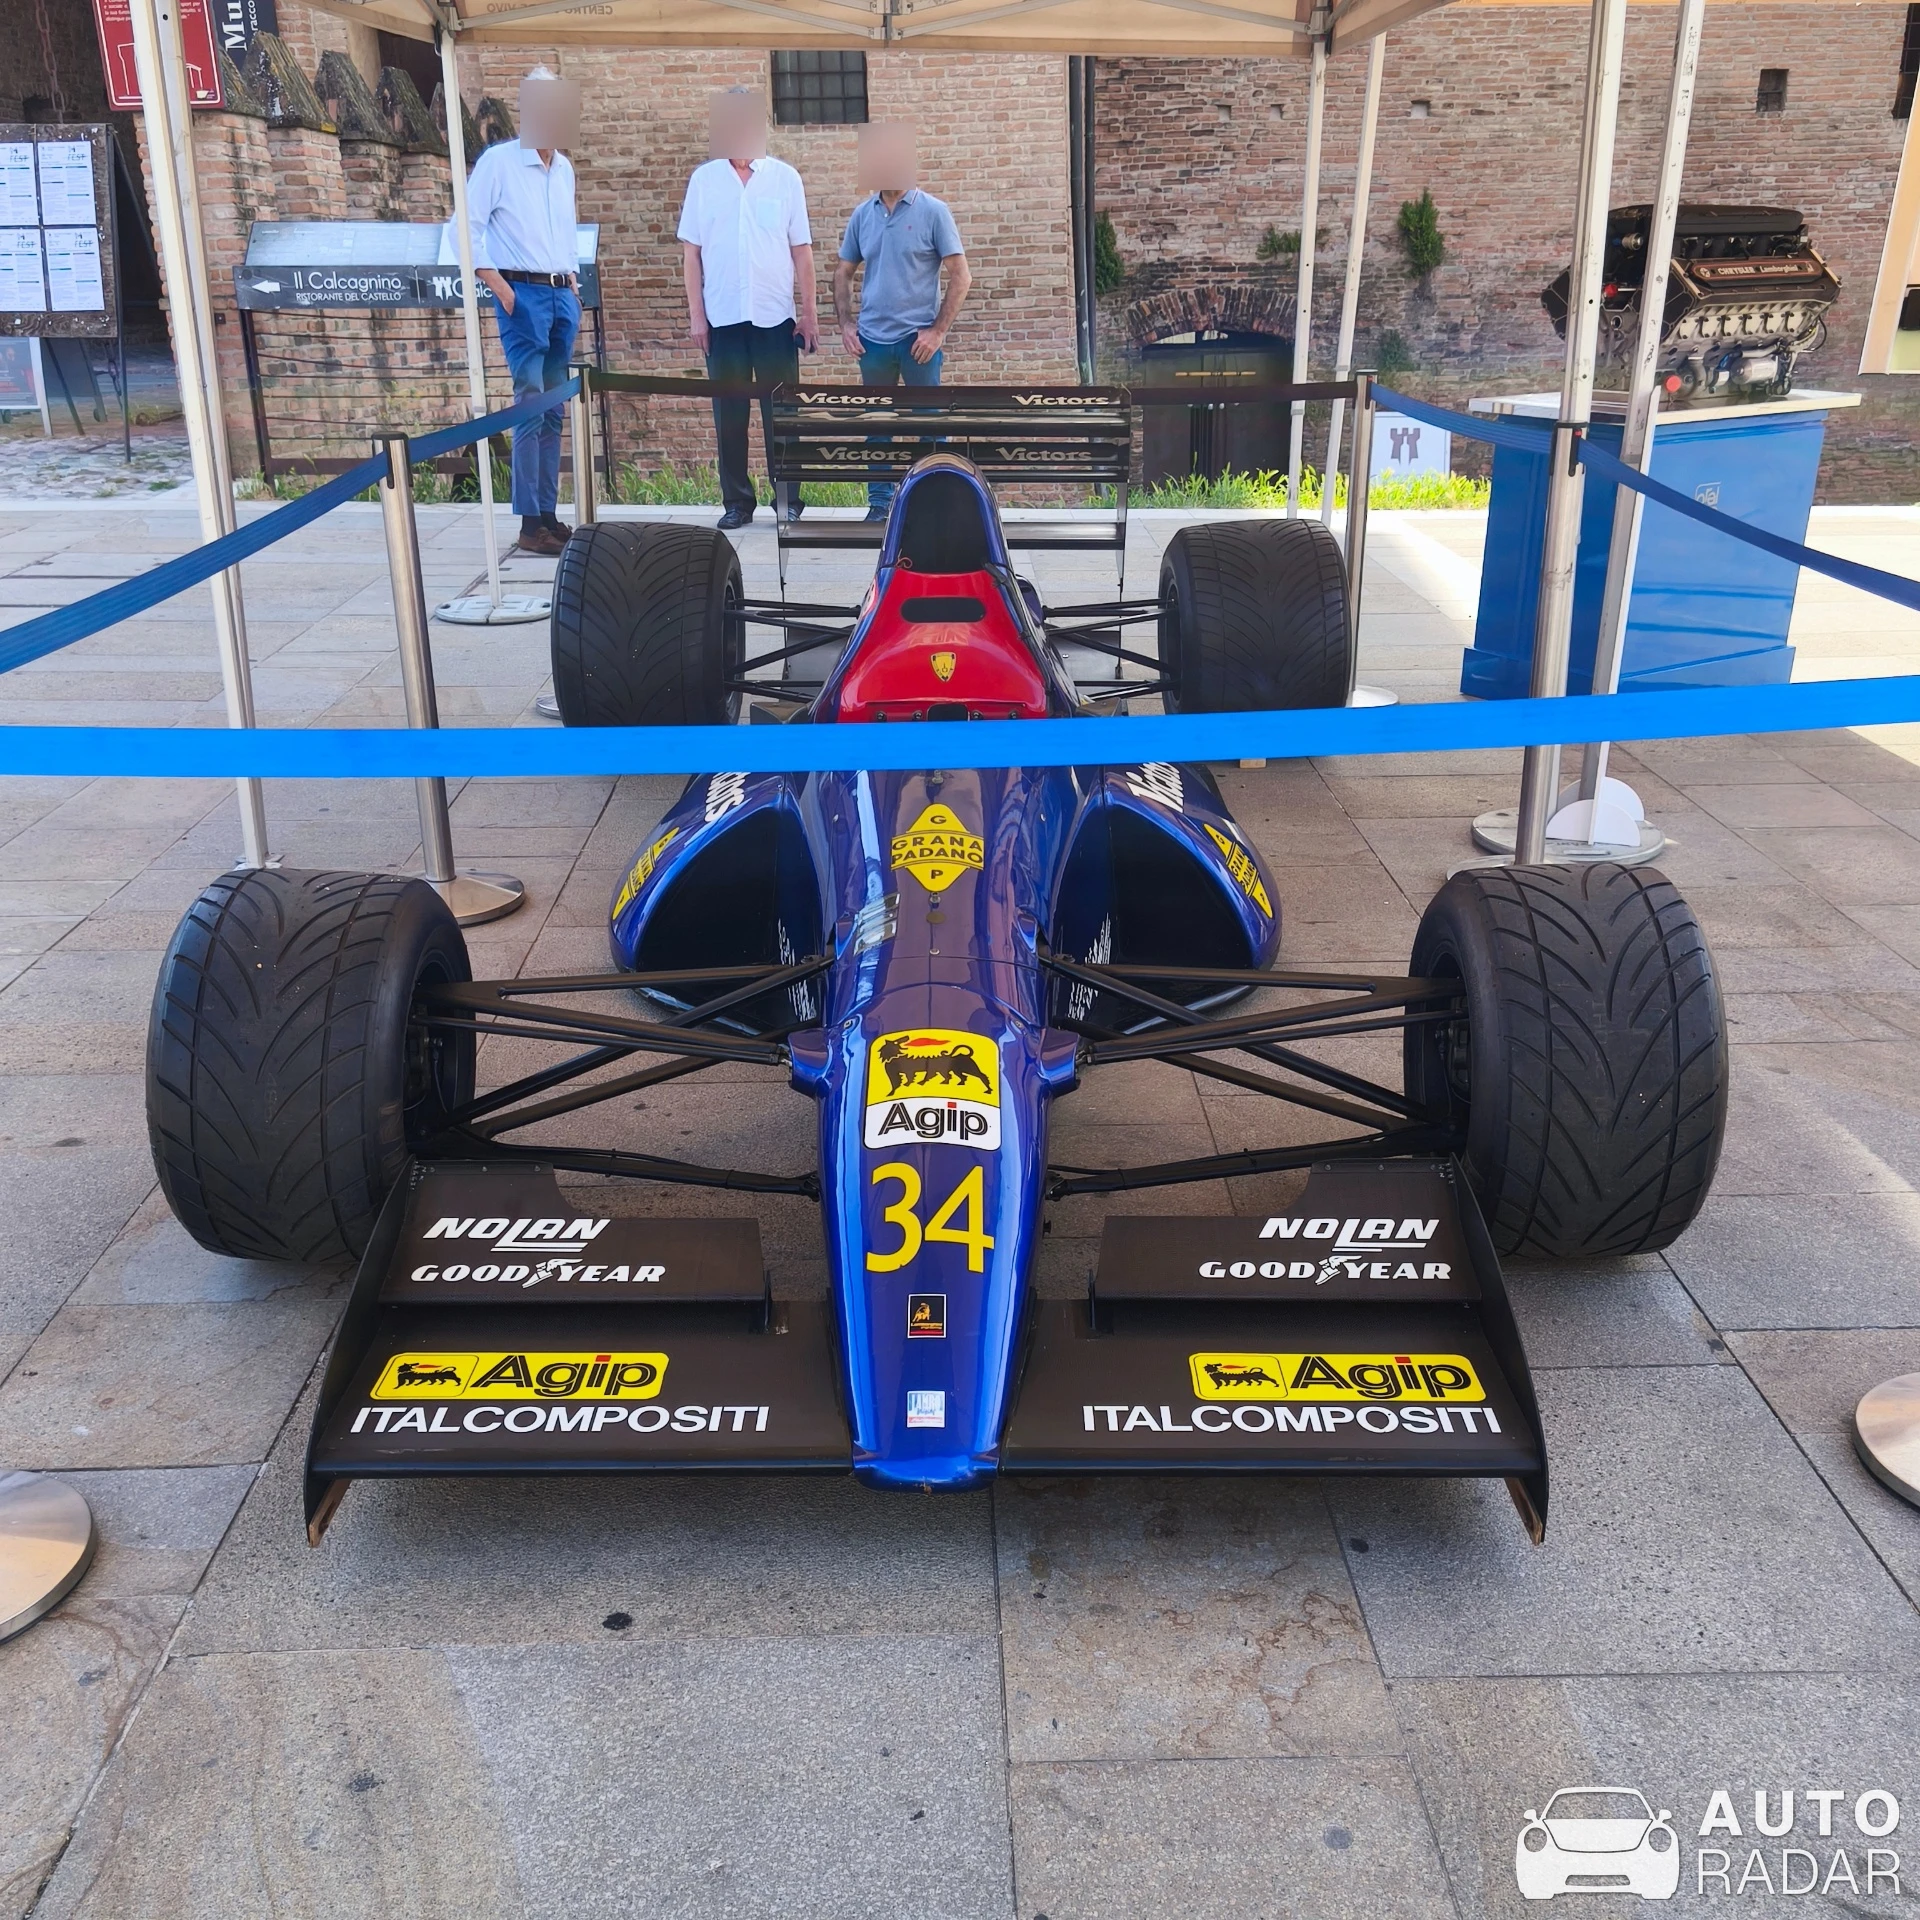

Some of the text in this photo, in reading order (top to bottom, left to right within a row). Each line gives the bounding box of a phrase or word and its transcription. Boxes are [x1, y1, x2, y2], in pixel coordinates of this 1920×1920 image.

[222, 0, 247, 51] Mu
[308, 271, 402, 292] Calcagnino
[296, 291, 402, 301] RISTORANTE DEL CASTELLO
[796, 392, 893, 405] Victors
[1012, 394, 1109, 406] Victors
[816, 447, 912, 462] Victors
[995, 447, 1092, 462] Victors
[930, 815, 947, 825] G
[892, 835, 983, 851] GRANA
[891, 848, 983, 865] PADANO
[930, 869, 944, 880] P
[877, 1102, 988, 1140] Agip
[865, 1162, 995, 1274] 34
[423, 1217, 611, 1252] NOLAN
[1258, 1217, 1440, 1252] NOLAN
[471, 1355, 658, 1397] Agip
[1290, 1355, 1472, 1398] Agip
[350, 1405, 770, 1434] ITALCOMPOSITI
[1082, 1405, 1502, 1435] ITALCOMPOSITI
